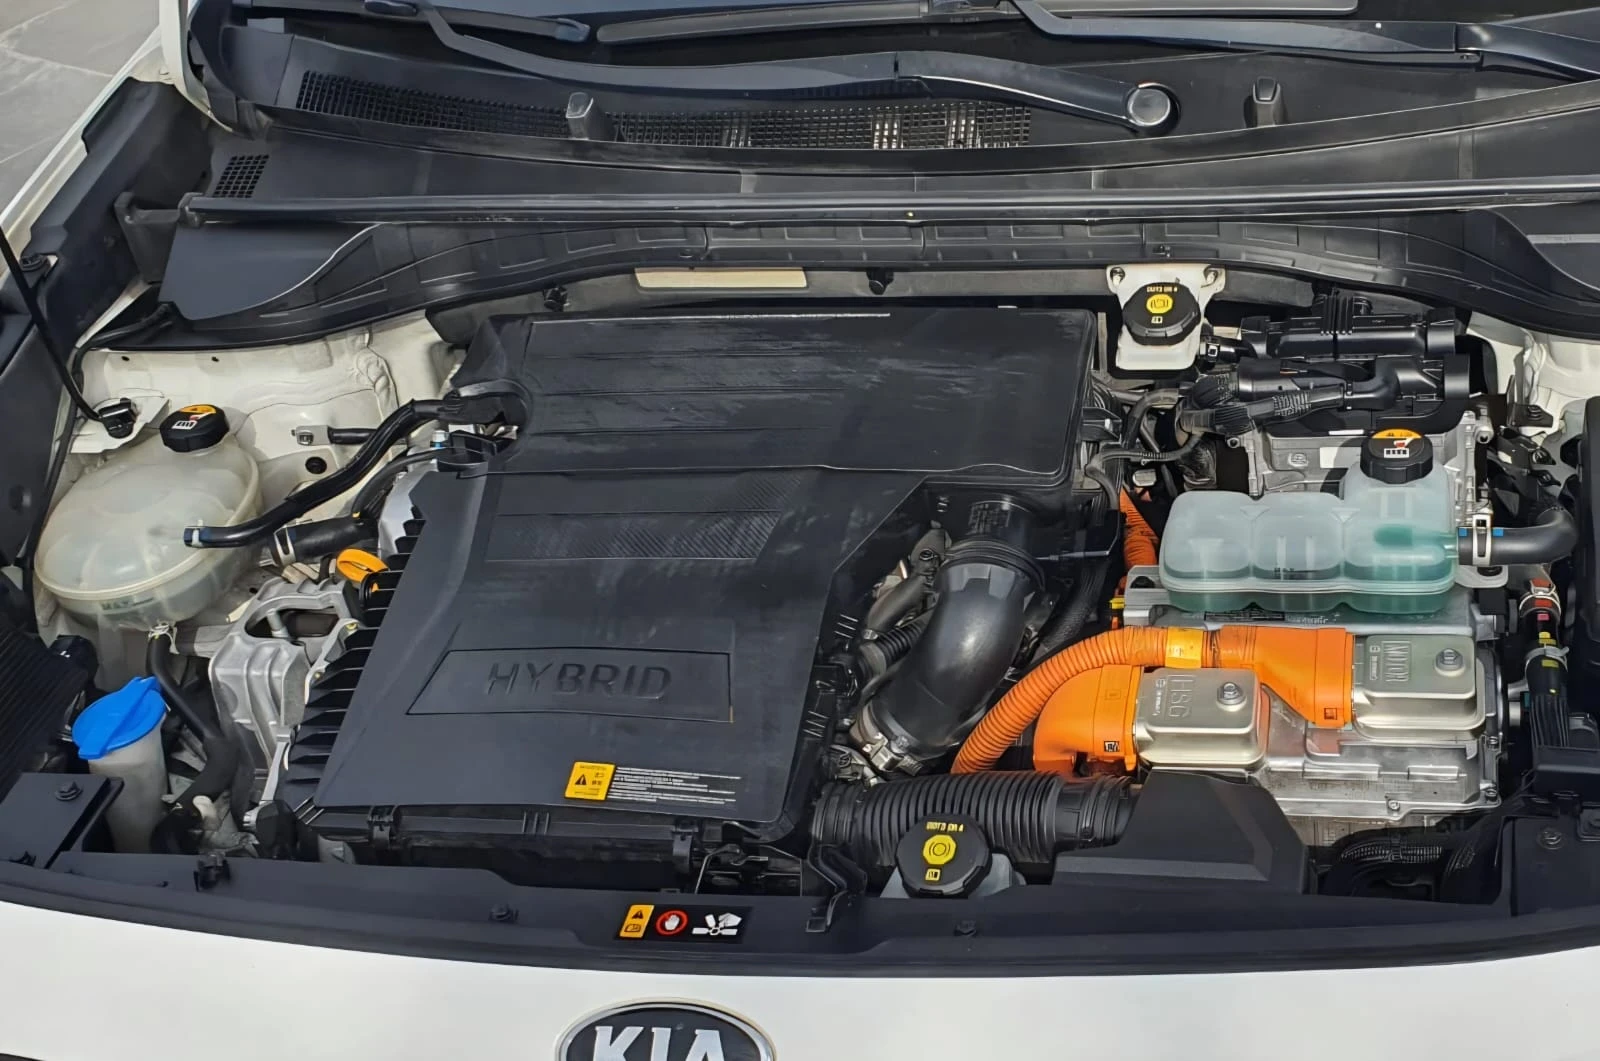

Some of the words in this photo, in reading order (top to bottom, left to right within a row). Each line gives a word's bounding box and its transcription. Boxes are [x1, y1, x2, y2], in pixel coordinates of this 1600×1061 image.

[485, 662, 672, 700] HYBRID
[1383, 645, 1409, 682] MOTOR
[593, 1025, 724, 1061] KIA
